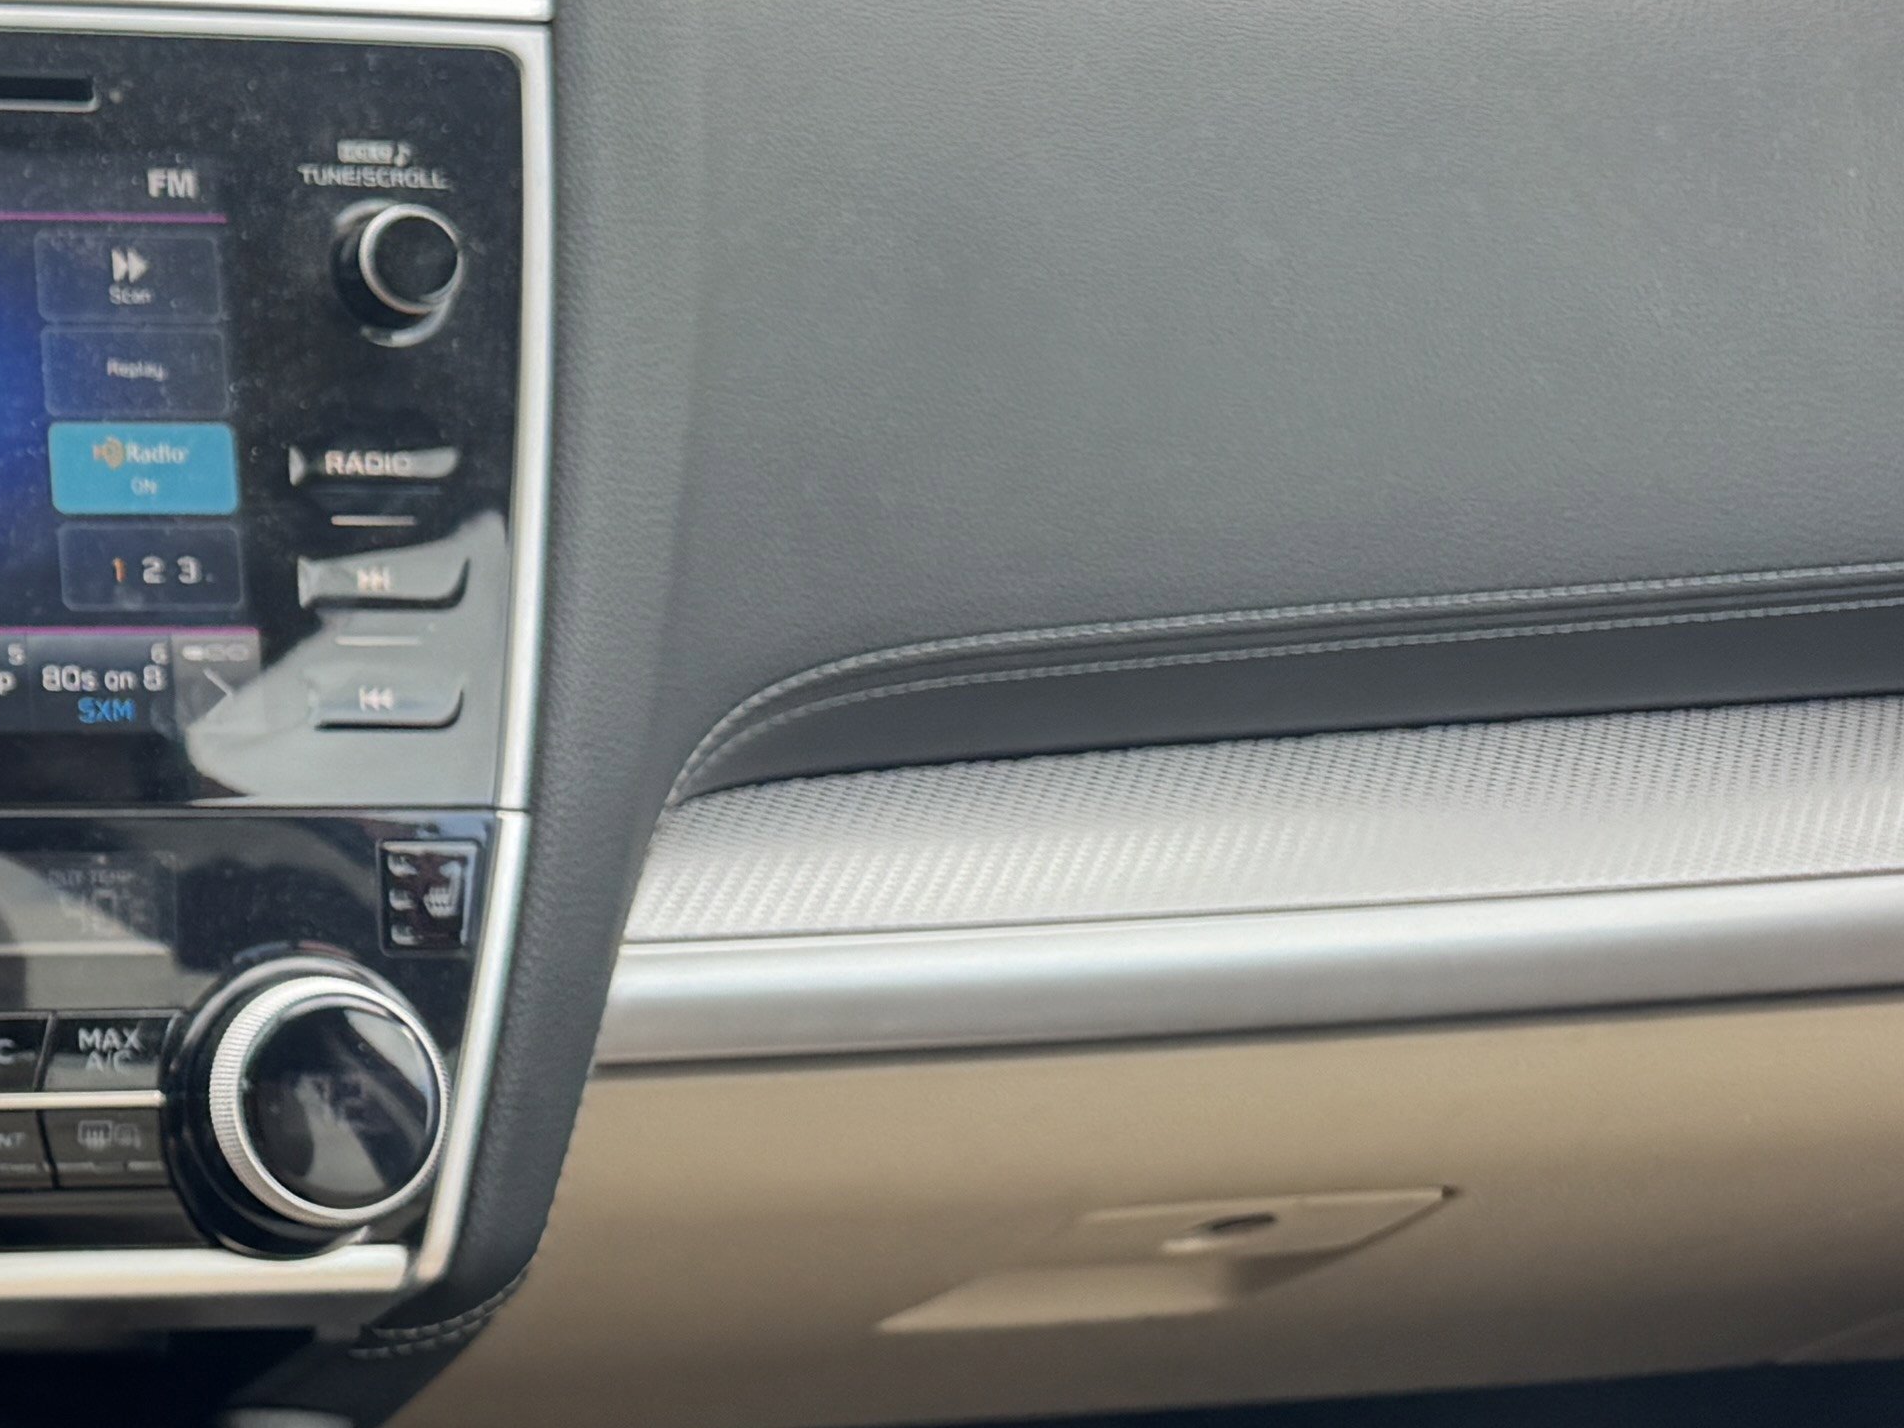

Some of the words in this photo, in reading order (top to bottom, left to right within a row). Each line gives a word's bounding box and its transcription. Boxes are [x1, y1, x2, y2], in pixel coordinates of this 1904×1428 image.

[147, 168, 197, 198] FM
[323, 450, 413, 476] RADIO
[112, 557, 126, 583] 1
[142, 556, 166, 584] 2
[177, 556, 203, 584] 3
[42, 666, 95, 692] 80s
[104, 670, 133, 691] on
[143, 665, 163, 692] 8
[77, 697, 136, 723] SXM
[77, 1027, 145, 1052] MAX
